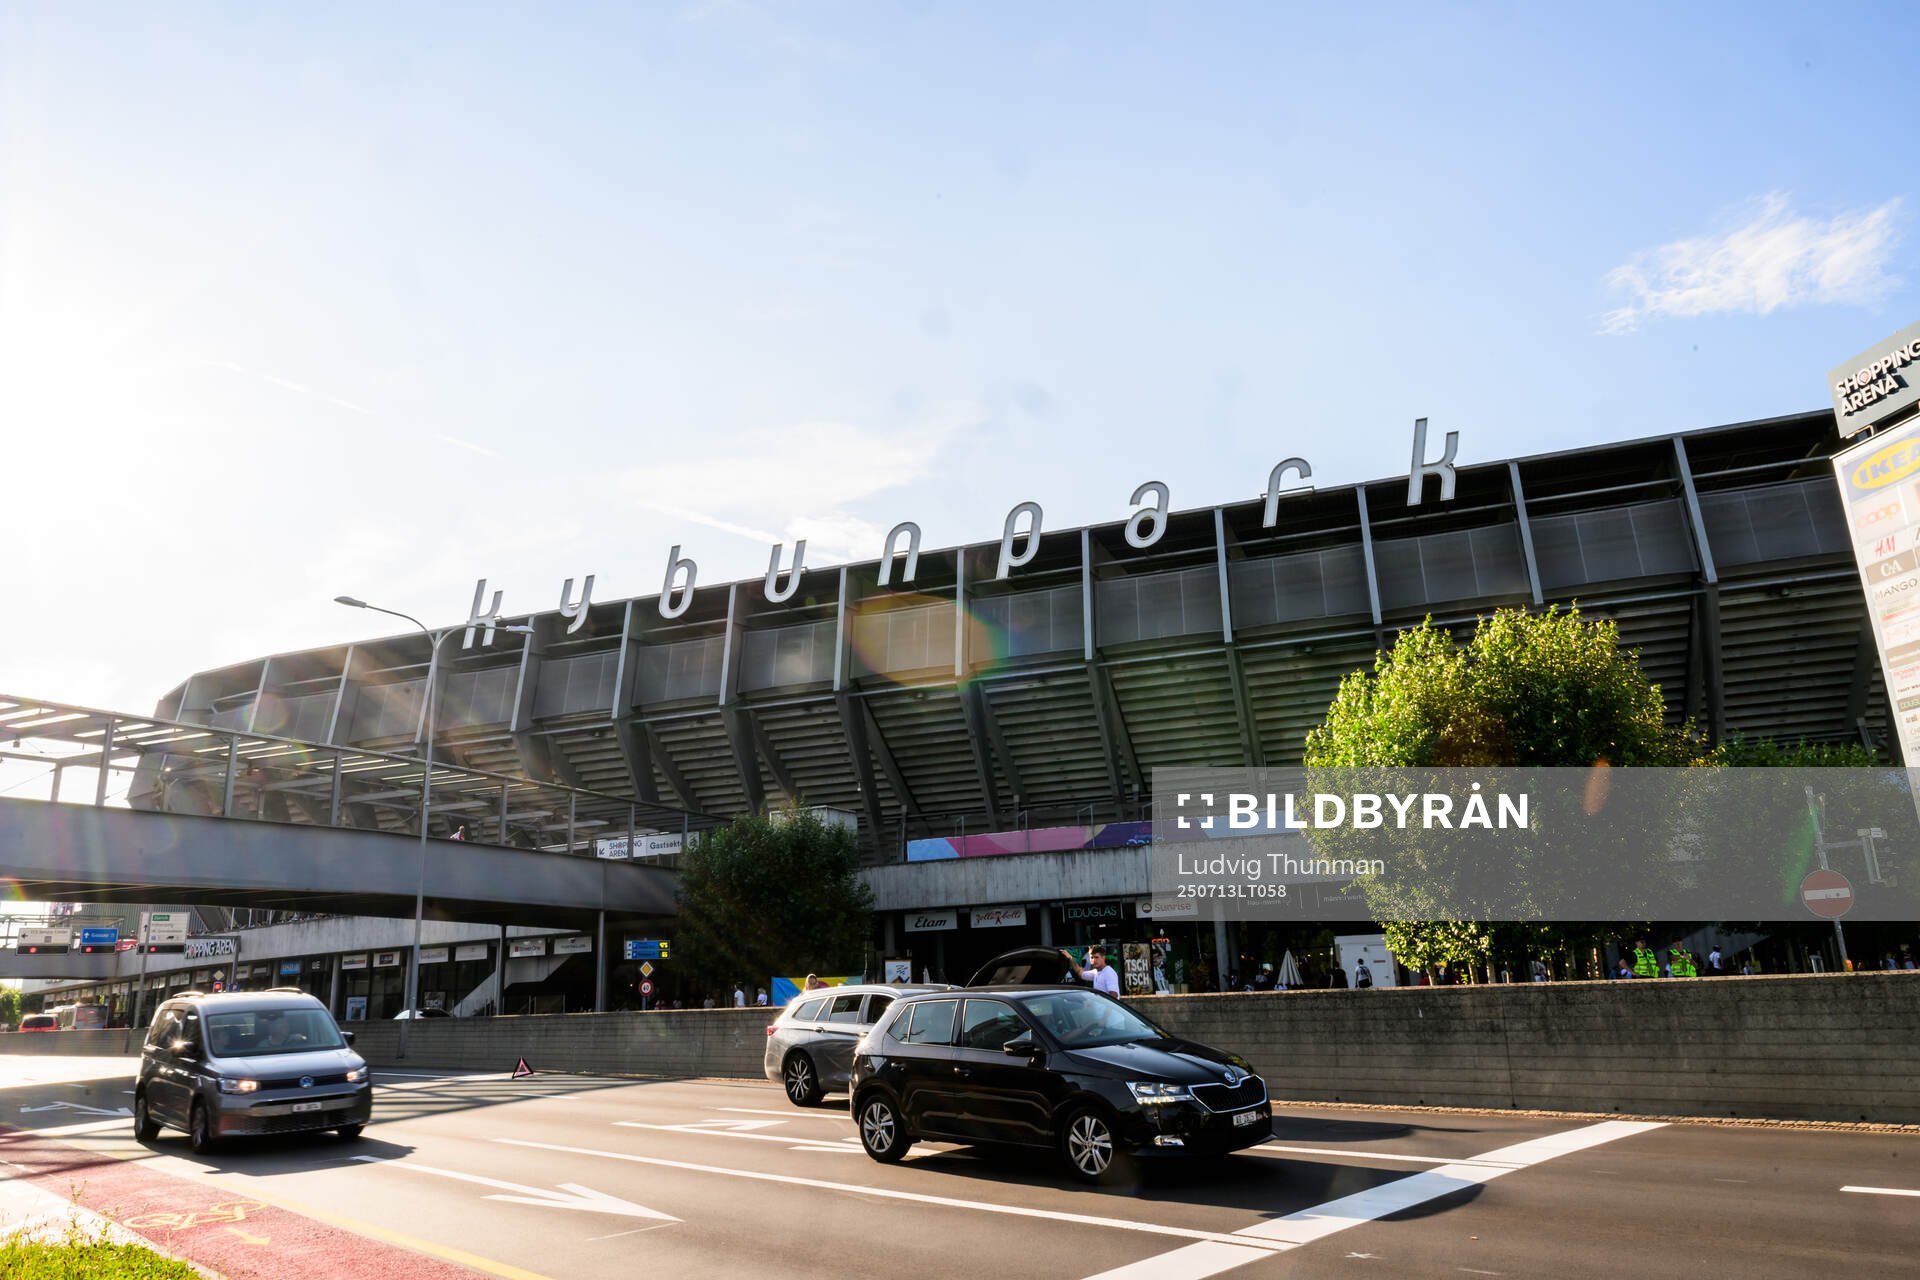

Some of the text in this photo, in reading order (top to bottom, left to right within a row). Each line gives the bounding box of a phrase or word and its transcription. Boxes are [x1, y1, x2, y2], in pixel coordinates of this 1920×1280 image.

[1836, 339, 1920, 398] SHOPPING
[1841, 372, 1899, 416] ARENA
[462, 417, 1460, 650] kybunpark
[1874, 578, 1918, 601] MANGO
[609, 839, 643, 850] SHOPNG
[1068, 906, 1117, 919] DOUGLAS
[1154, 902, 1192, 912] Sunrise
[914, 916, 947, 928] Etam
[184, 941, 215, 960] HOPPING
[1125, 959, 1149, 972] TSCH
[1126, 972, 1150, 985] TSCH
